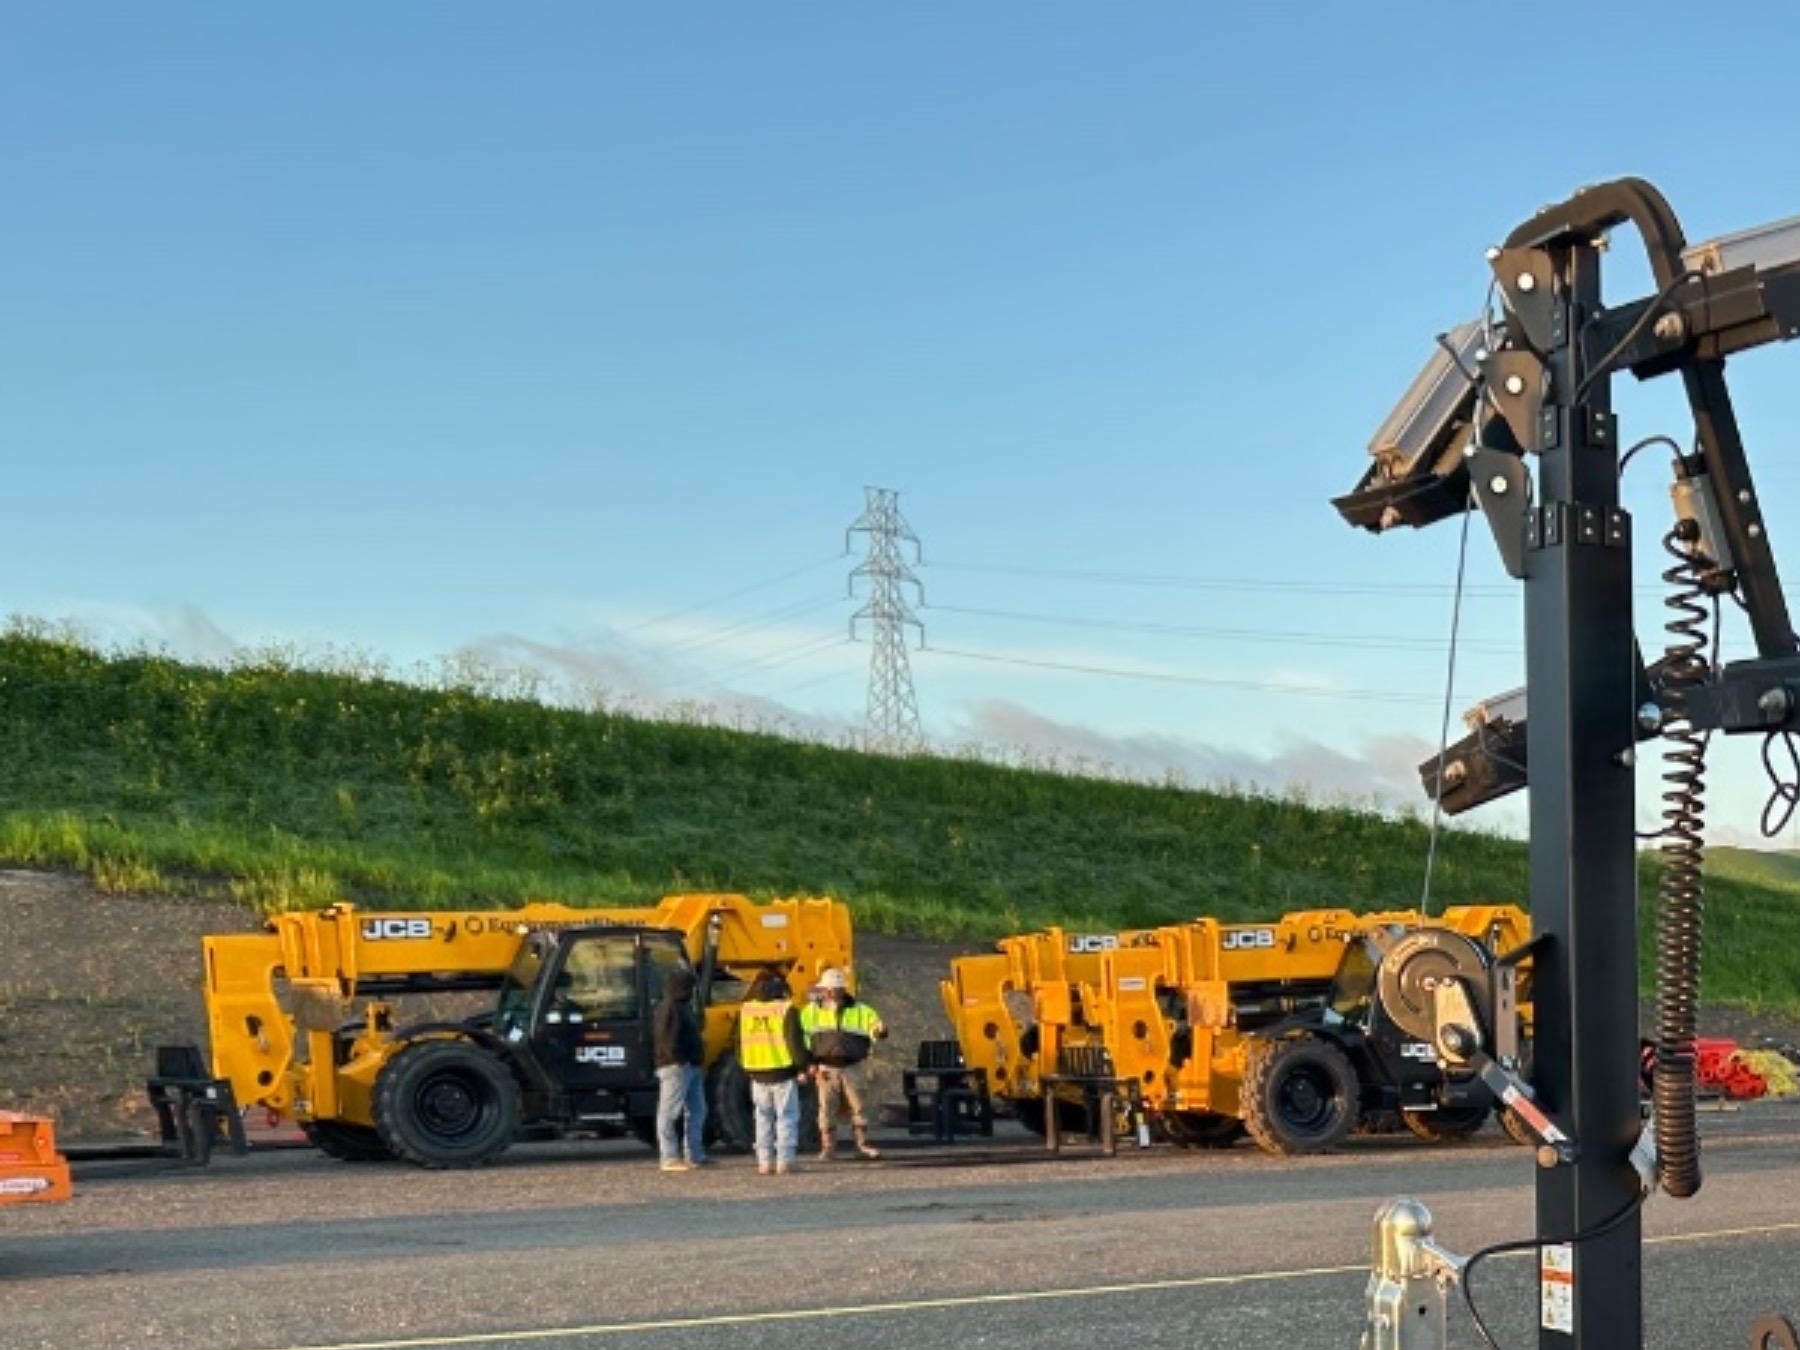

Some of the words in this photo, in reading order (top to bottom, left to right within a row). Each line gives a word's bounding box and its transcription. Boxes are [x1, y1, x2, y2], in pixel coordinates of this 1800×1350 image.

[361, 919, 431, 938] JCB
[1222, 930, 1275, 949] JCB
[575, 1047, 625, 1062] JCB
